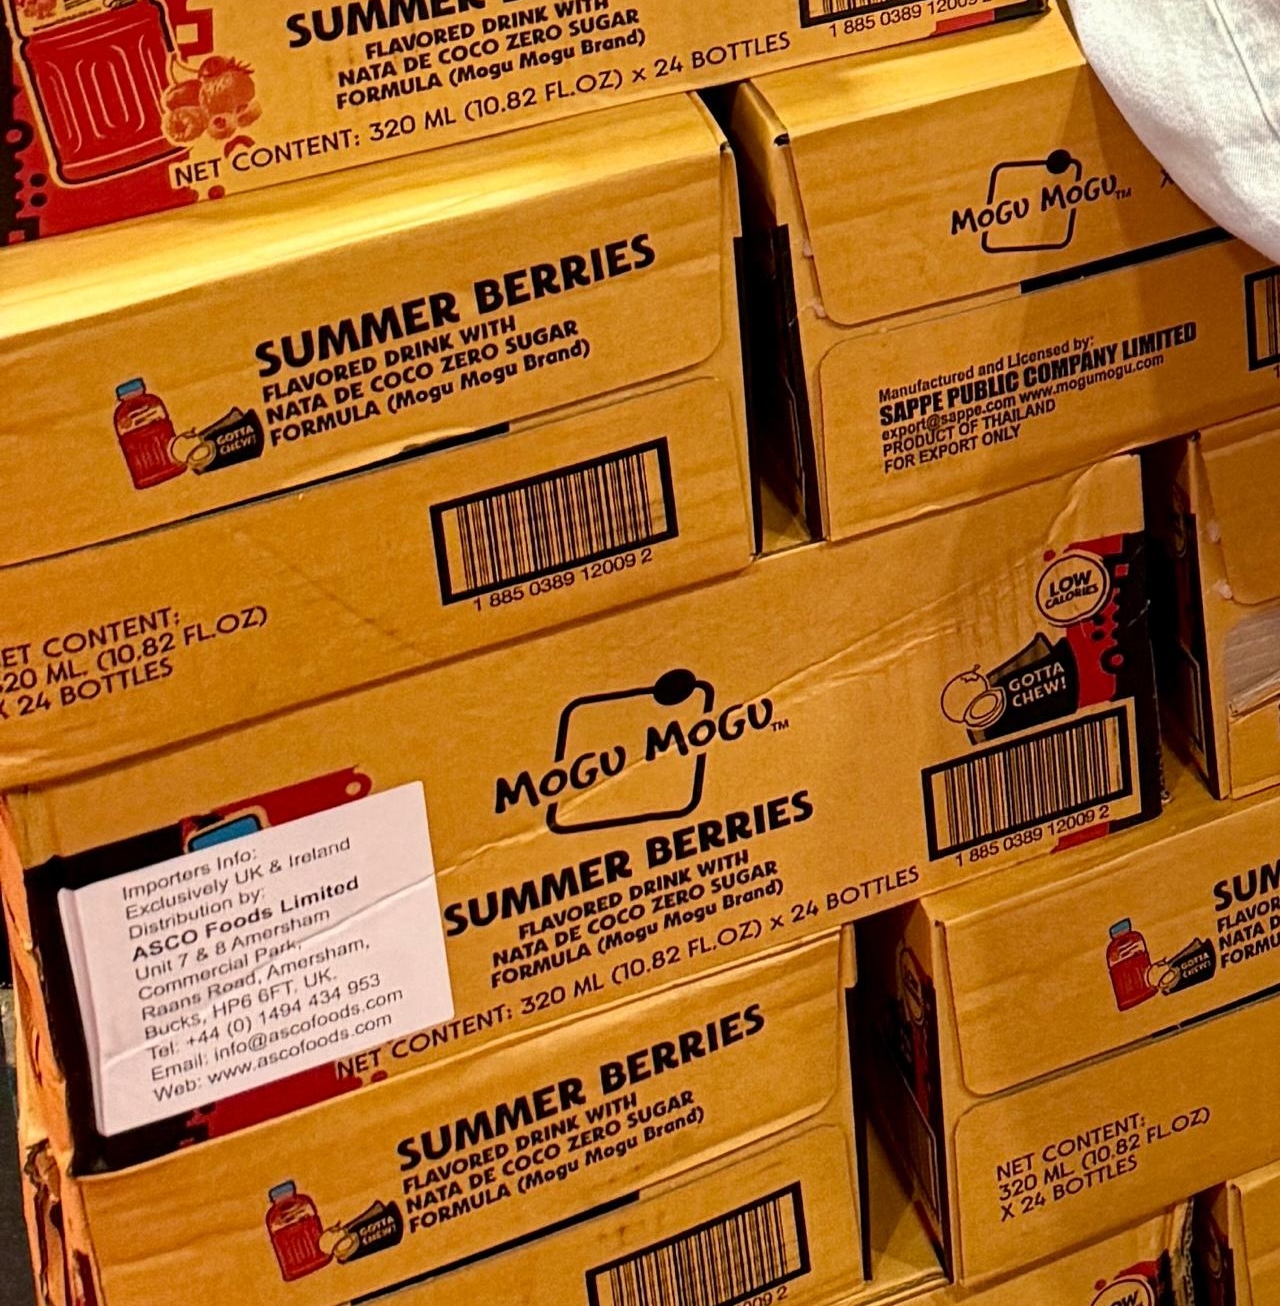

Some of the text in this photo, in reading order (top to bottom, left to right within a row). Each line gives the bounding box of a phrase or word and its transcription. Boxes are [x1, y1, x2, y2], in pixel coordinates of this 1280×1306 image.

[365, 22, 475, 60] FLAVORED
[481, 6, 549, 35] DRINK
[828, 21, 837, 38] 1
[842, 14, 876, 35] 885
[879, 3, 922, 26] 0389
[174, 32, 791, 188] NET CONTENT: 320 ML (10.82 FL.OZ) x 24 BOTTLES
[255, 234, 656, 378] SUMMER BERRIES
[269, 341, 590, 447] FORMULA (Mogu Mogu Brand)
[878, 335, 1097, 404] Manufactured and Licensed by:
[879, 322, 1197, 426] SAPPE PUBLIC COMPANY LIMITED
[882, 355, 1165, 442] export@sappe.com www.mogumogu.com
[882, 399, 1056, 457] PRODUCT OF THAILAND
[883, 424, 1020, 474] FOR EXPORT ONLY
[121, 848, 256, 901] Importers Info:
[124, 836, 350, 921] Exclusively UK & Ireland
[443, 789, 815, 936] SUMMER BERRIES
[127, 887, 264, 940] Distribution by:
[131, 874, 359, 962] ASCO Foods Limited
[134, 909, 330, 981] Unit 7 & 8 Amersham
[137, 952, 248, 1001] Commercial
[141, 992, 202, 1021] Raans
[266, 938, 370, 980] Amersham,
[145, 972, 380, 1060] Tel: +44 (0) 1494 434 953
[211, 992, 252, 1019] HP6
[150, 988, 403, 1082] Email: info@ascofoods.com
[152, 1013, 392, 1102] Web: www.ascofoods.com
[397, 1004, 765, 1171] SUMMER BERRIES
